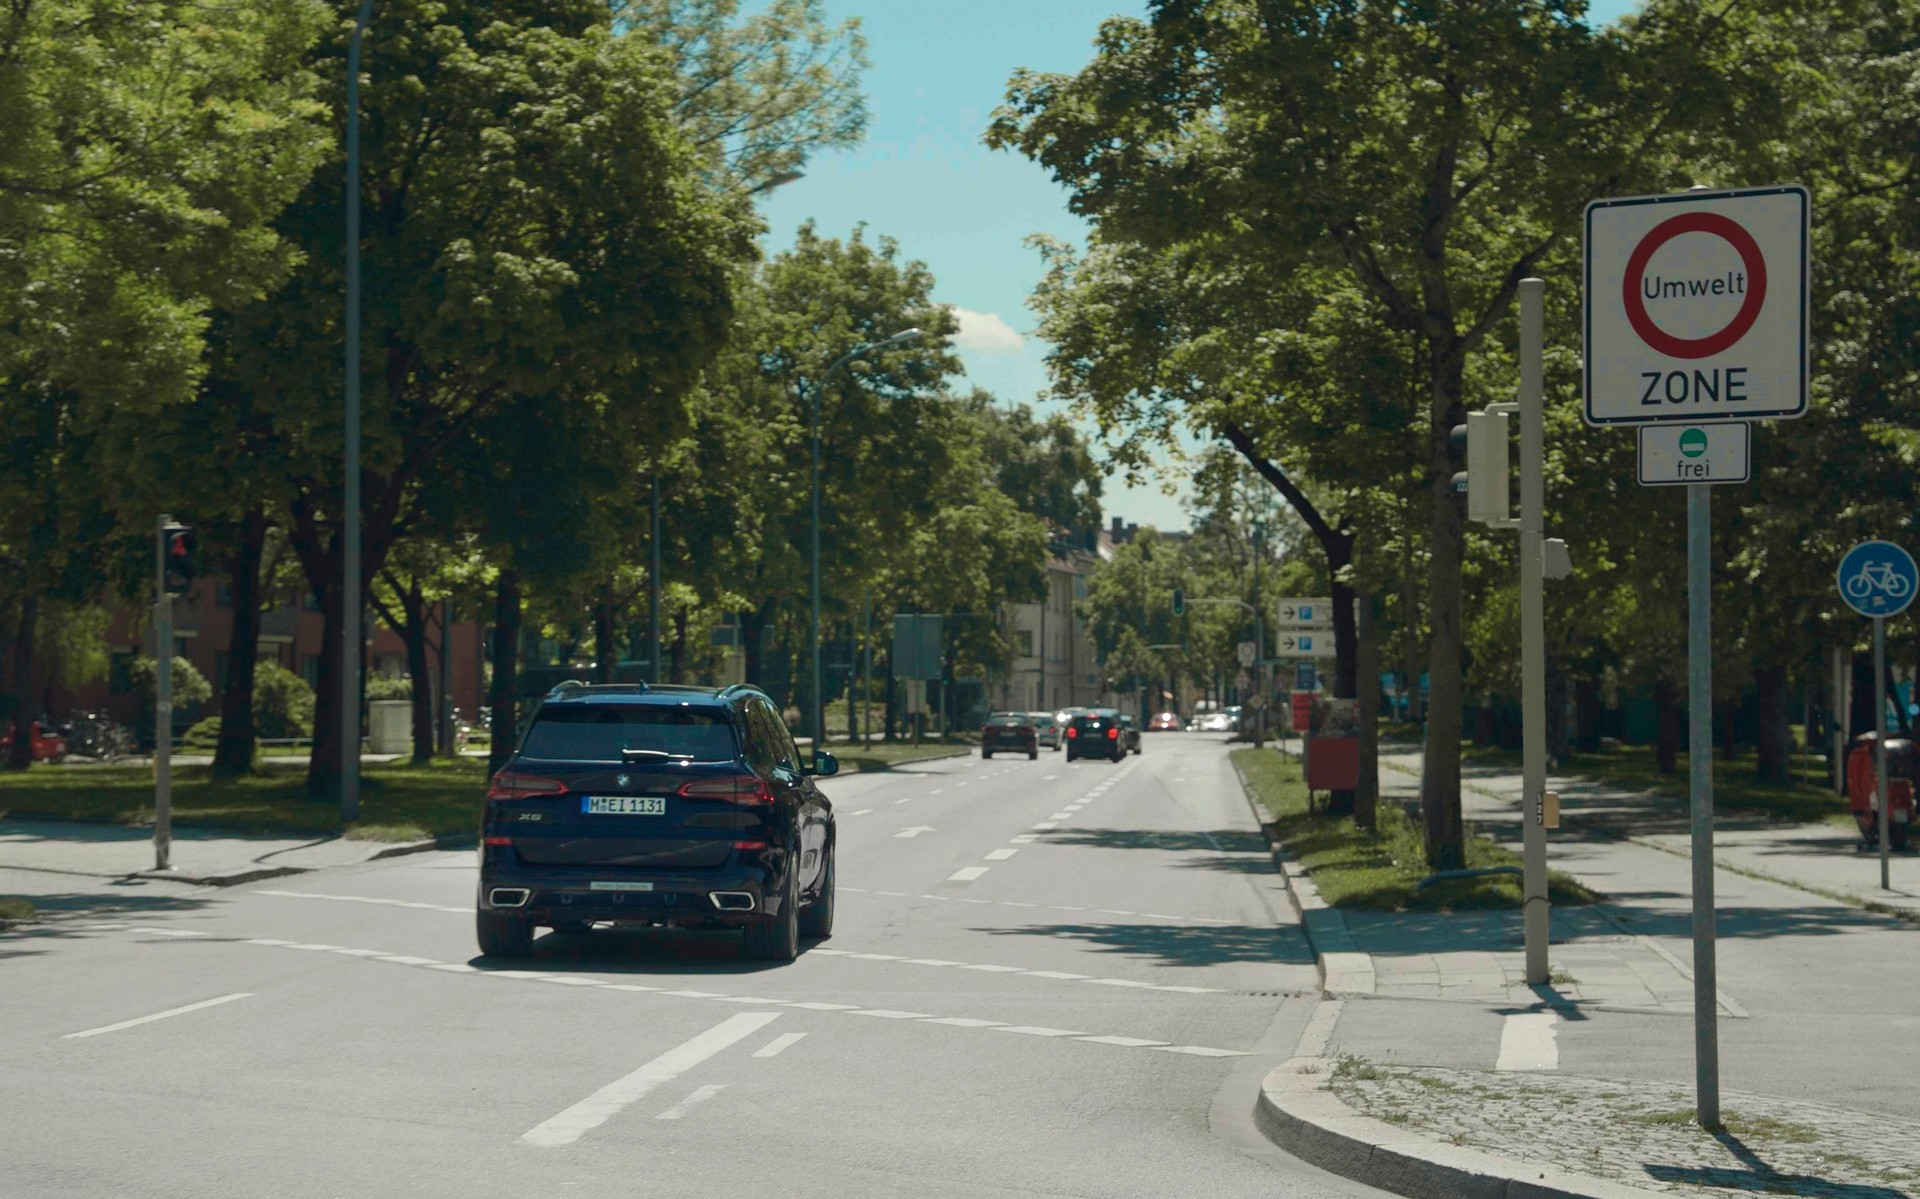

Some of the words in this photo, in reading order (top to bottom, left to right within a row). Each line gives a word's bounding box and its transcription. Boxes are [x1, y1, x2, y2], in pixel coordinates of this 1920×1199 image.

[1644, 272, 1744, 299] Umwelt
[1641, 367, 1748, 405] ZONE
[1677, 460, 1710, 477] frei
[631, 800, 664, 813] 1131
